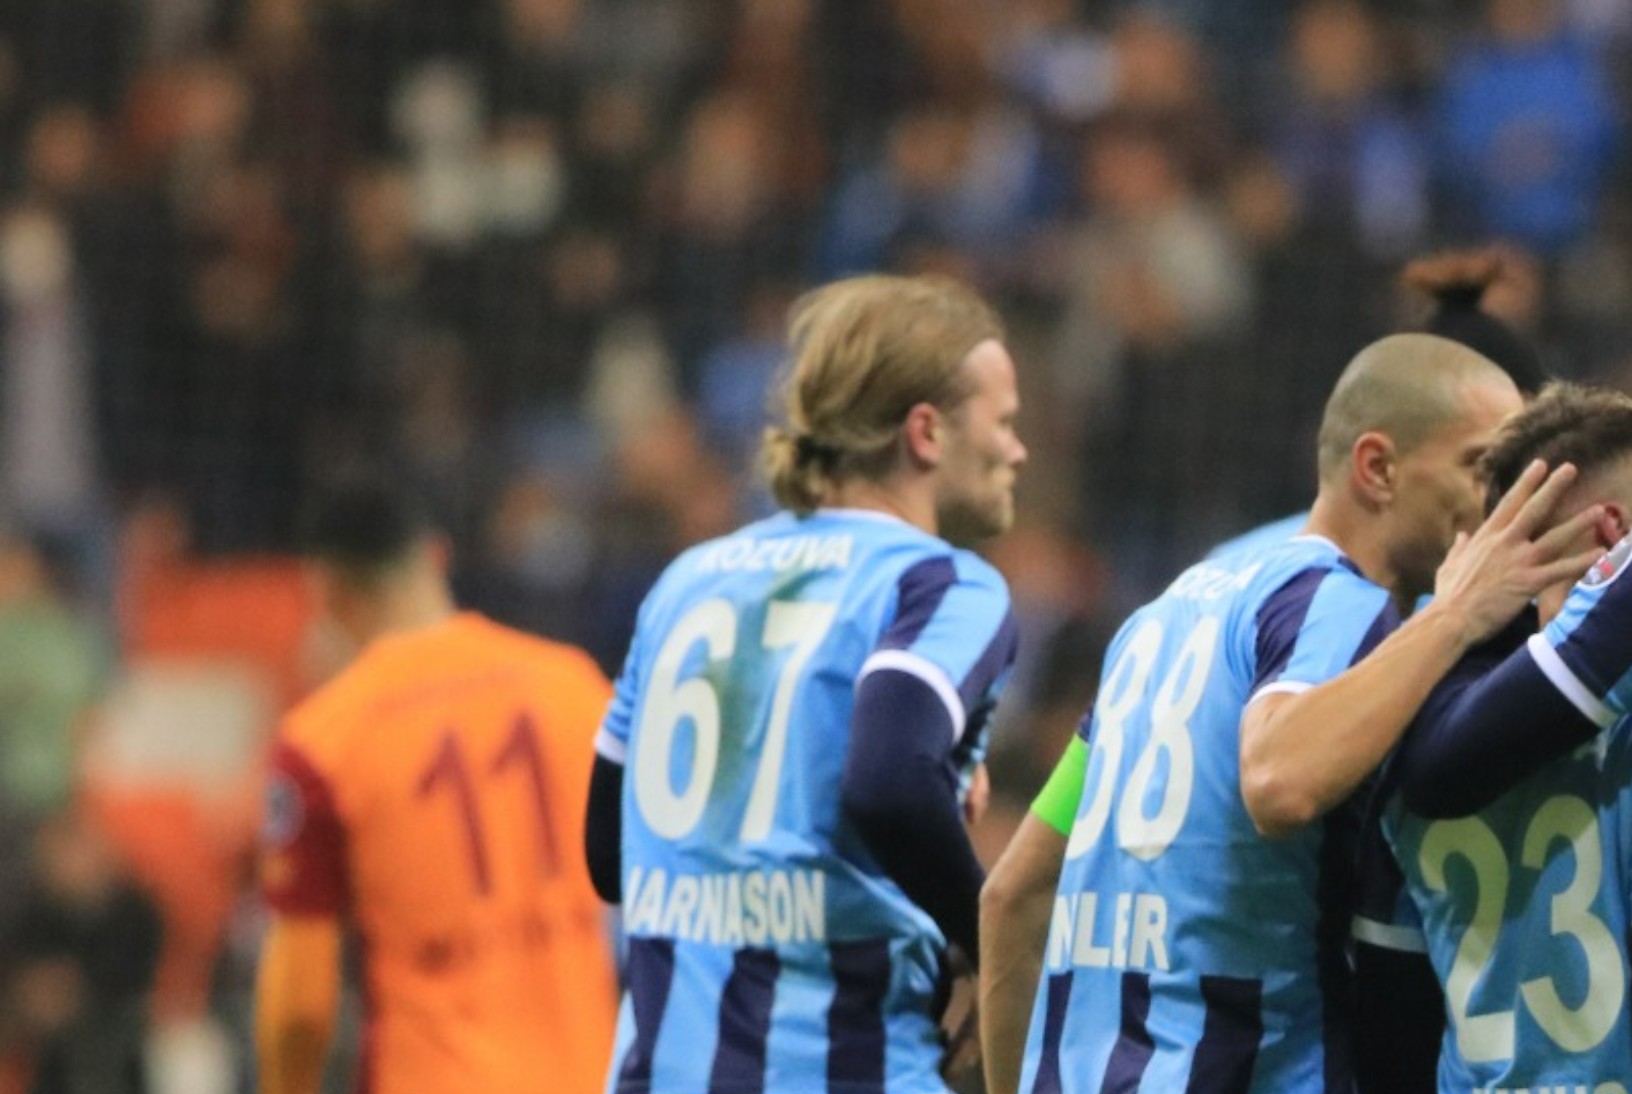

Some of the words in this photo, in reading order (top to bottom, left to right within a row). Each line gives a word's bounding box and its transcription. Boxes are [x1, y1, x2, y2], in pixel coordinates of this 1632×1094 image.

[416, 710, 564, 898] 11
[634, 597, 839, 842] 67
[1419, 794, 1626, 1063] 23
